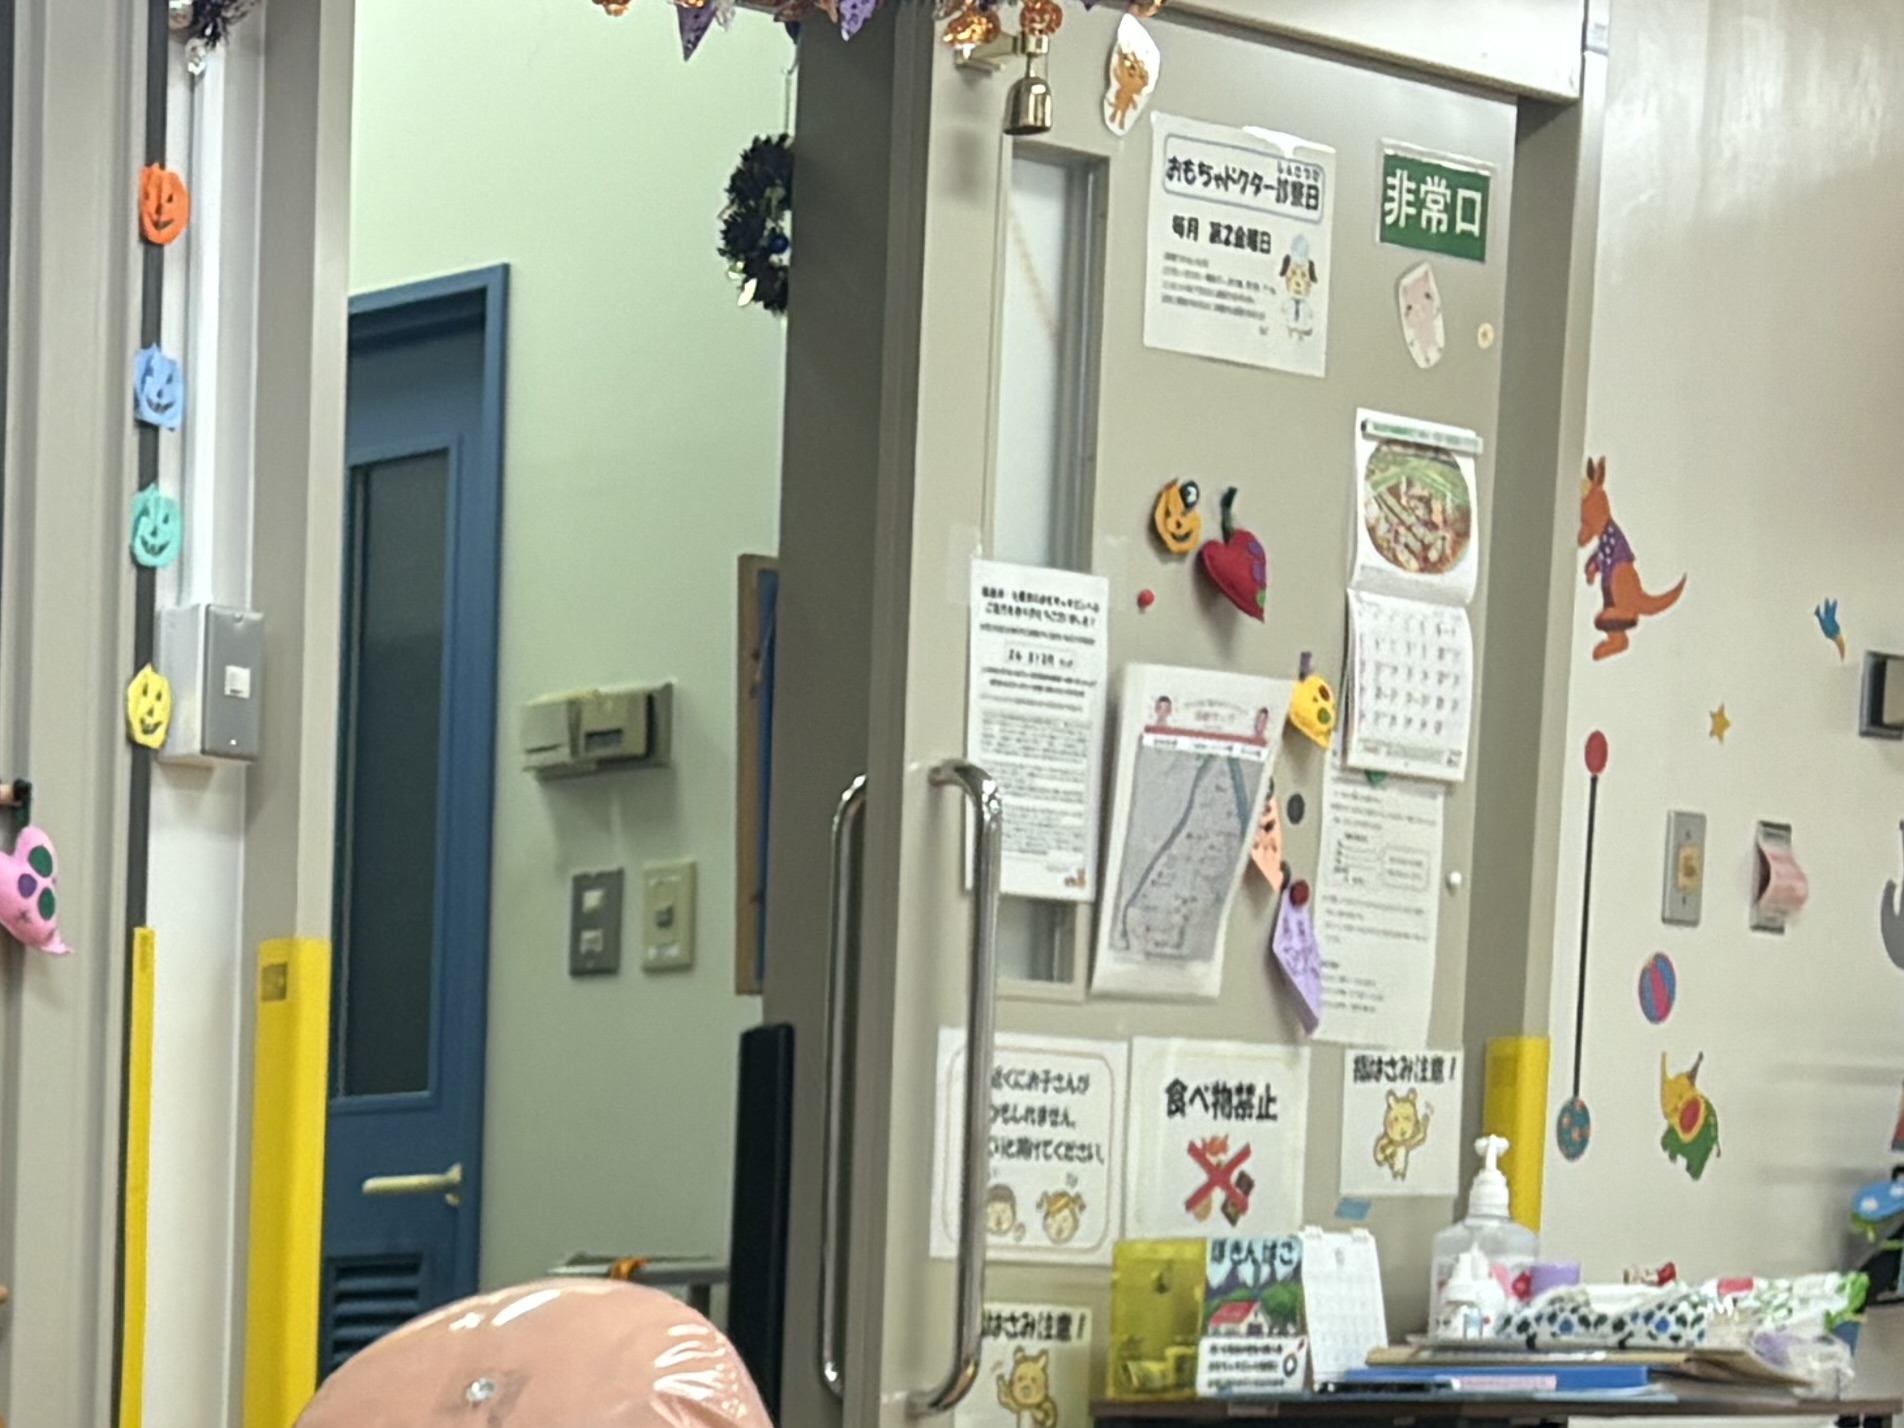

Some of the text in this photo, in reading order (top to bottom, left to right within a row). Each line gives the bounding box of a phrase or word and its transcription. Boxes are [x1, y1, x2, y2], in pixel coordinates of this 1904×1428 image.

[1383, 167, 1483, 239] 非常口
[1172, 214, 1199, 243] 毎月
[1164, 1077, 1279, 1123] 食べ物禁止
